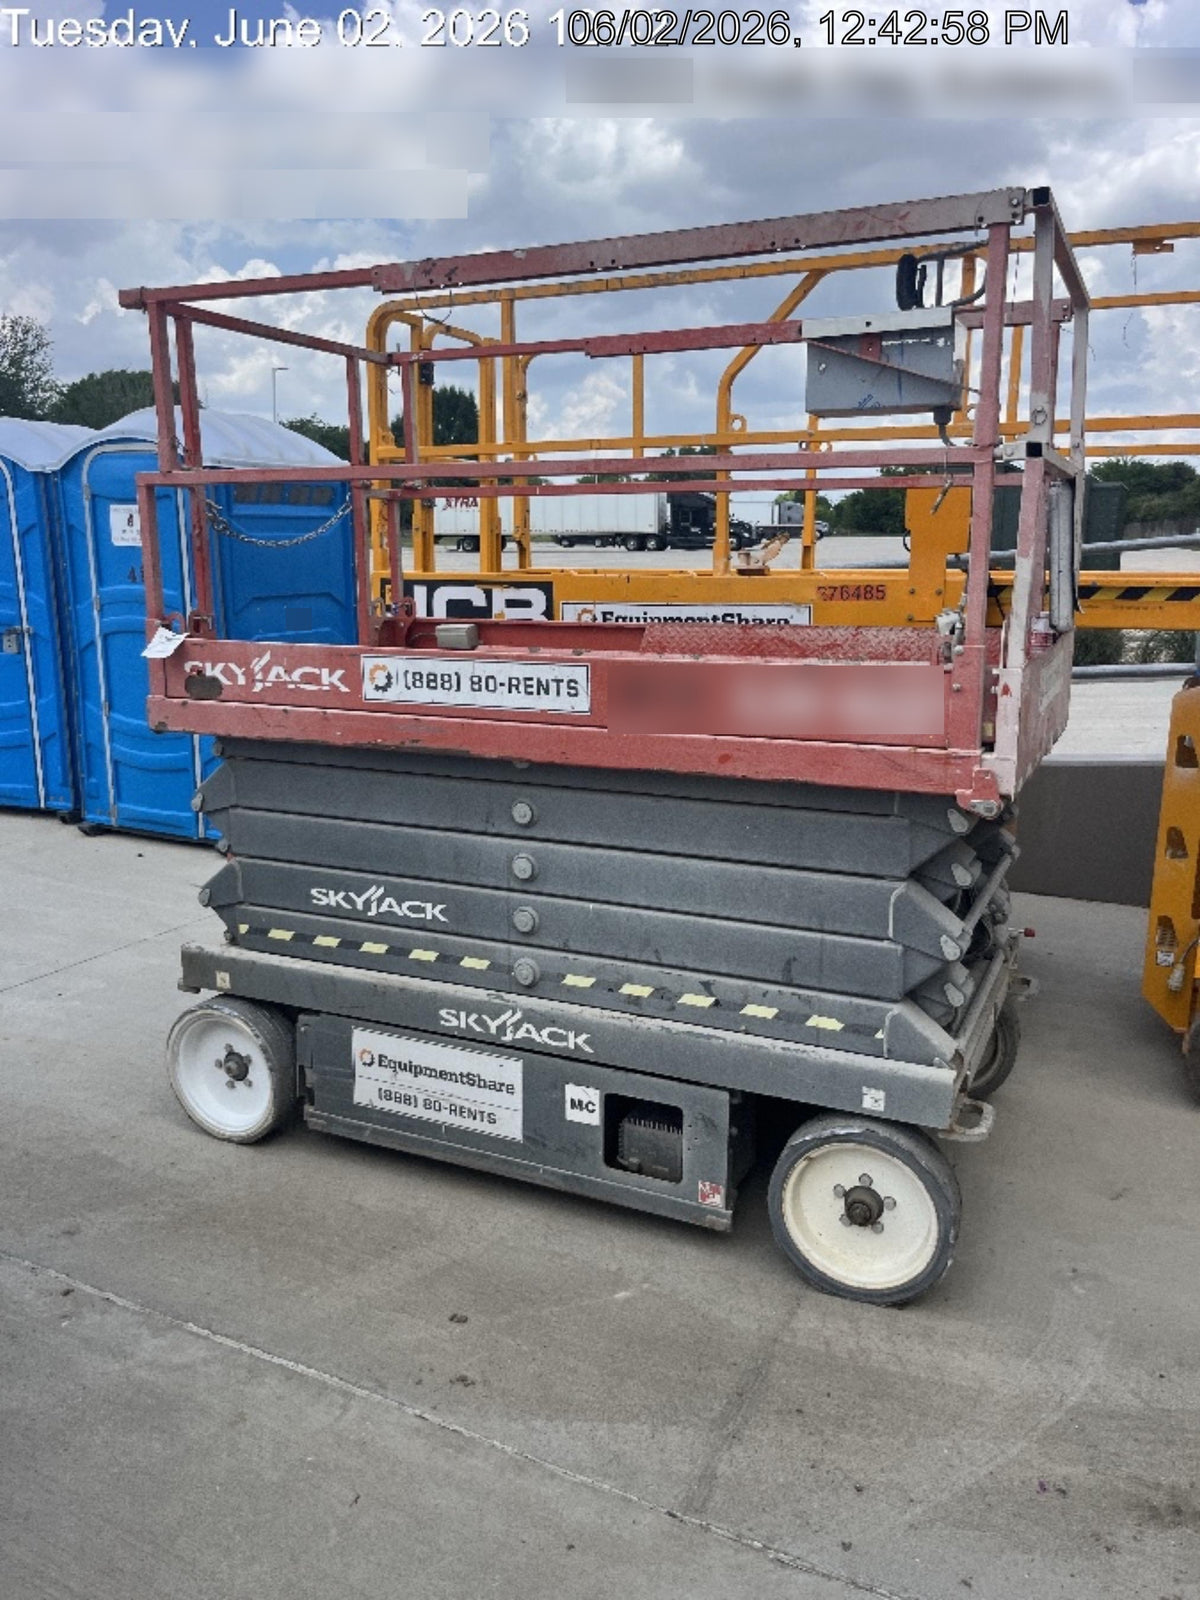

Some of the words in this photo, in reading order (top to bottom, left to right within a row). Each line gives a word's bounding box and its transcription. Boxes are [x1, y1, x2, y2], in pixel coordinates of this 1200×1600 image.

[403, 669, 461, 693] (888)
[470, 674, 579, 698] 80-RENTS
[310, 885, 449, 923] SKYJACK
[438, 1008, 594, 1054] SKYJACK
[377, 1053, 515, 1096] EquipmentShare
[377, 1087, 418, 1108] (888)
[422, 1098, 497, 1125] 80-RENTS
